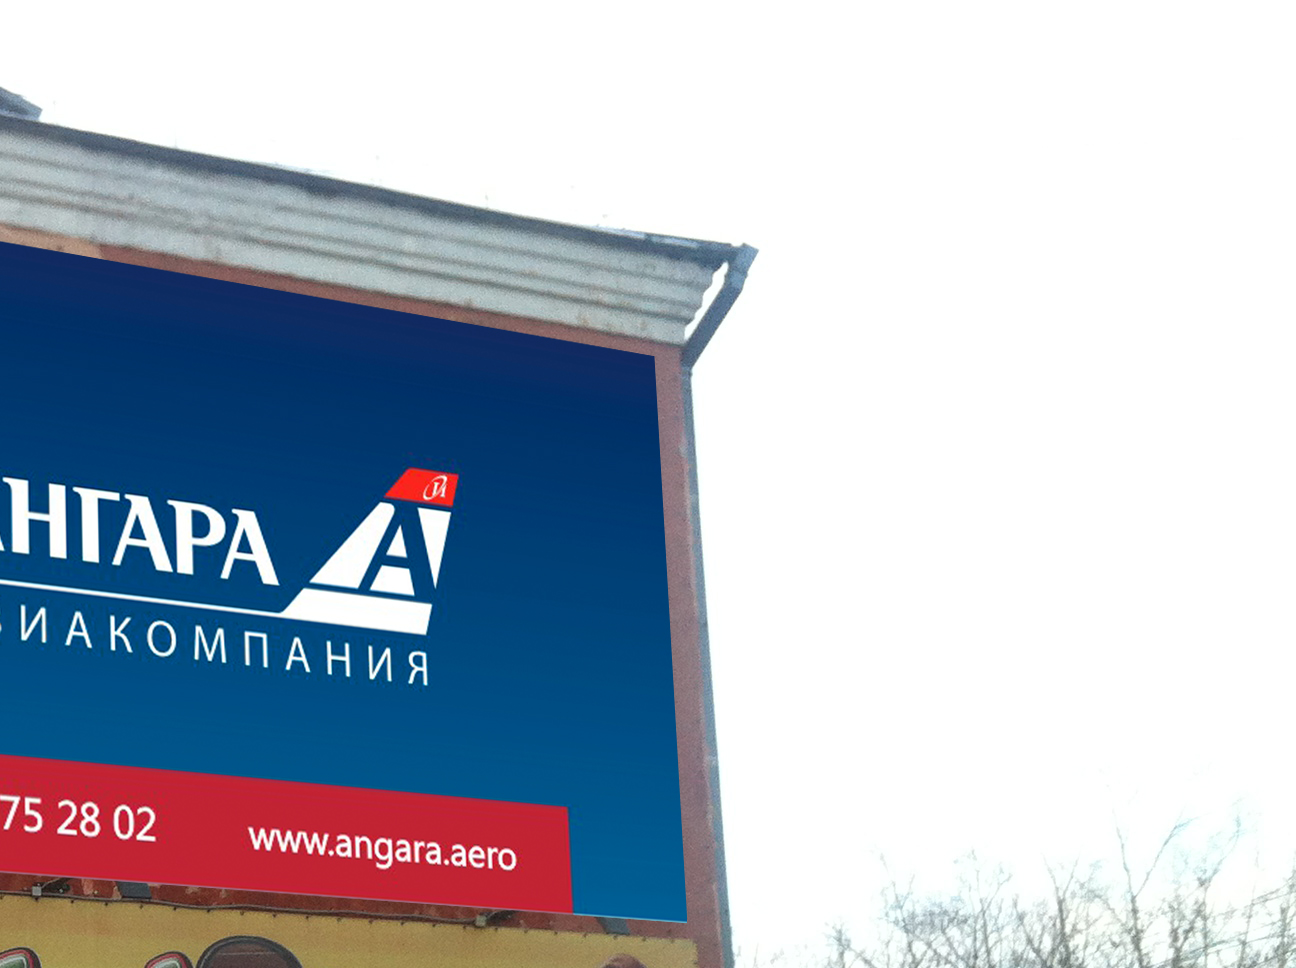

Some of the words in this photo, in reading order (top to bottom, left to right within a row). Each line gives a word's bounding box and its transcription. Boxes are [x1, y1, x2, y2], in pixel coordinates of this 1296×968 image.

[56, 799, 101, 838] 28
[113, 804, 157, 842] 02
[247, 826, 517, 871] www.angara.aero
